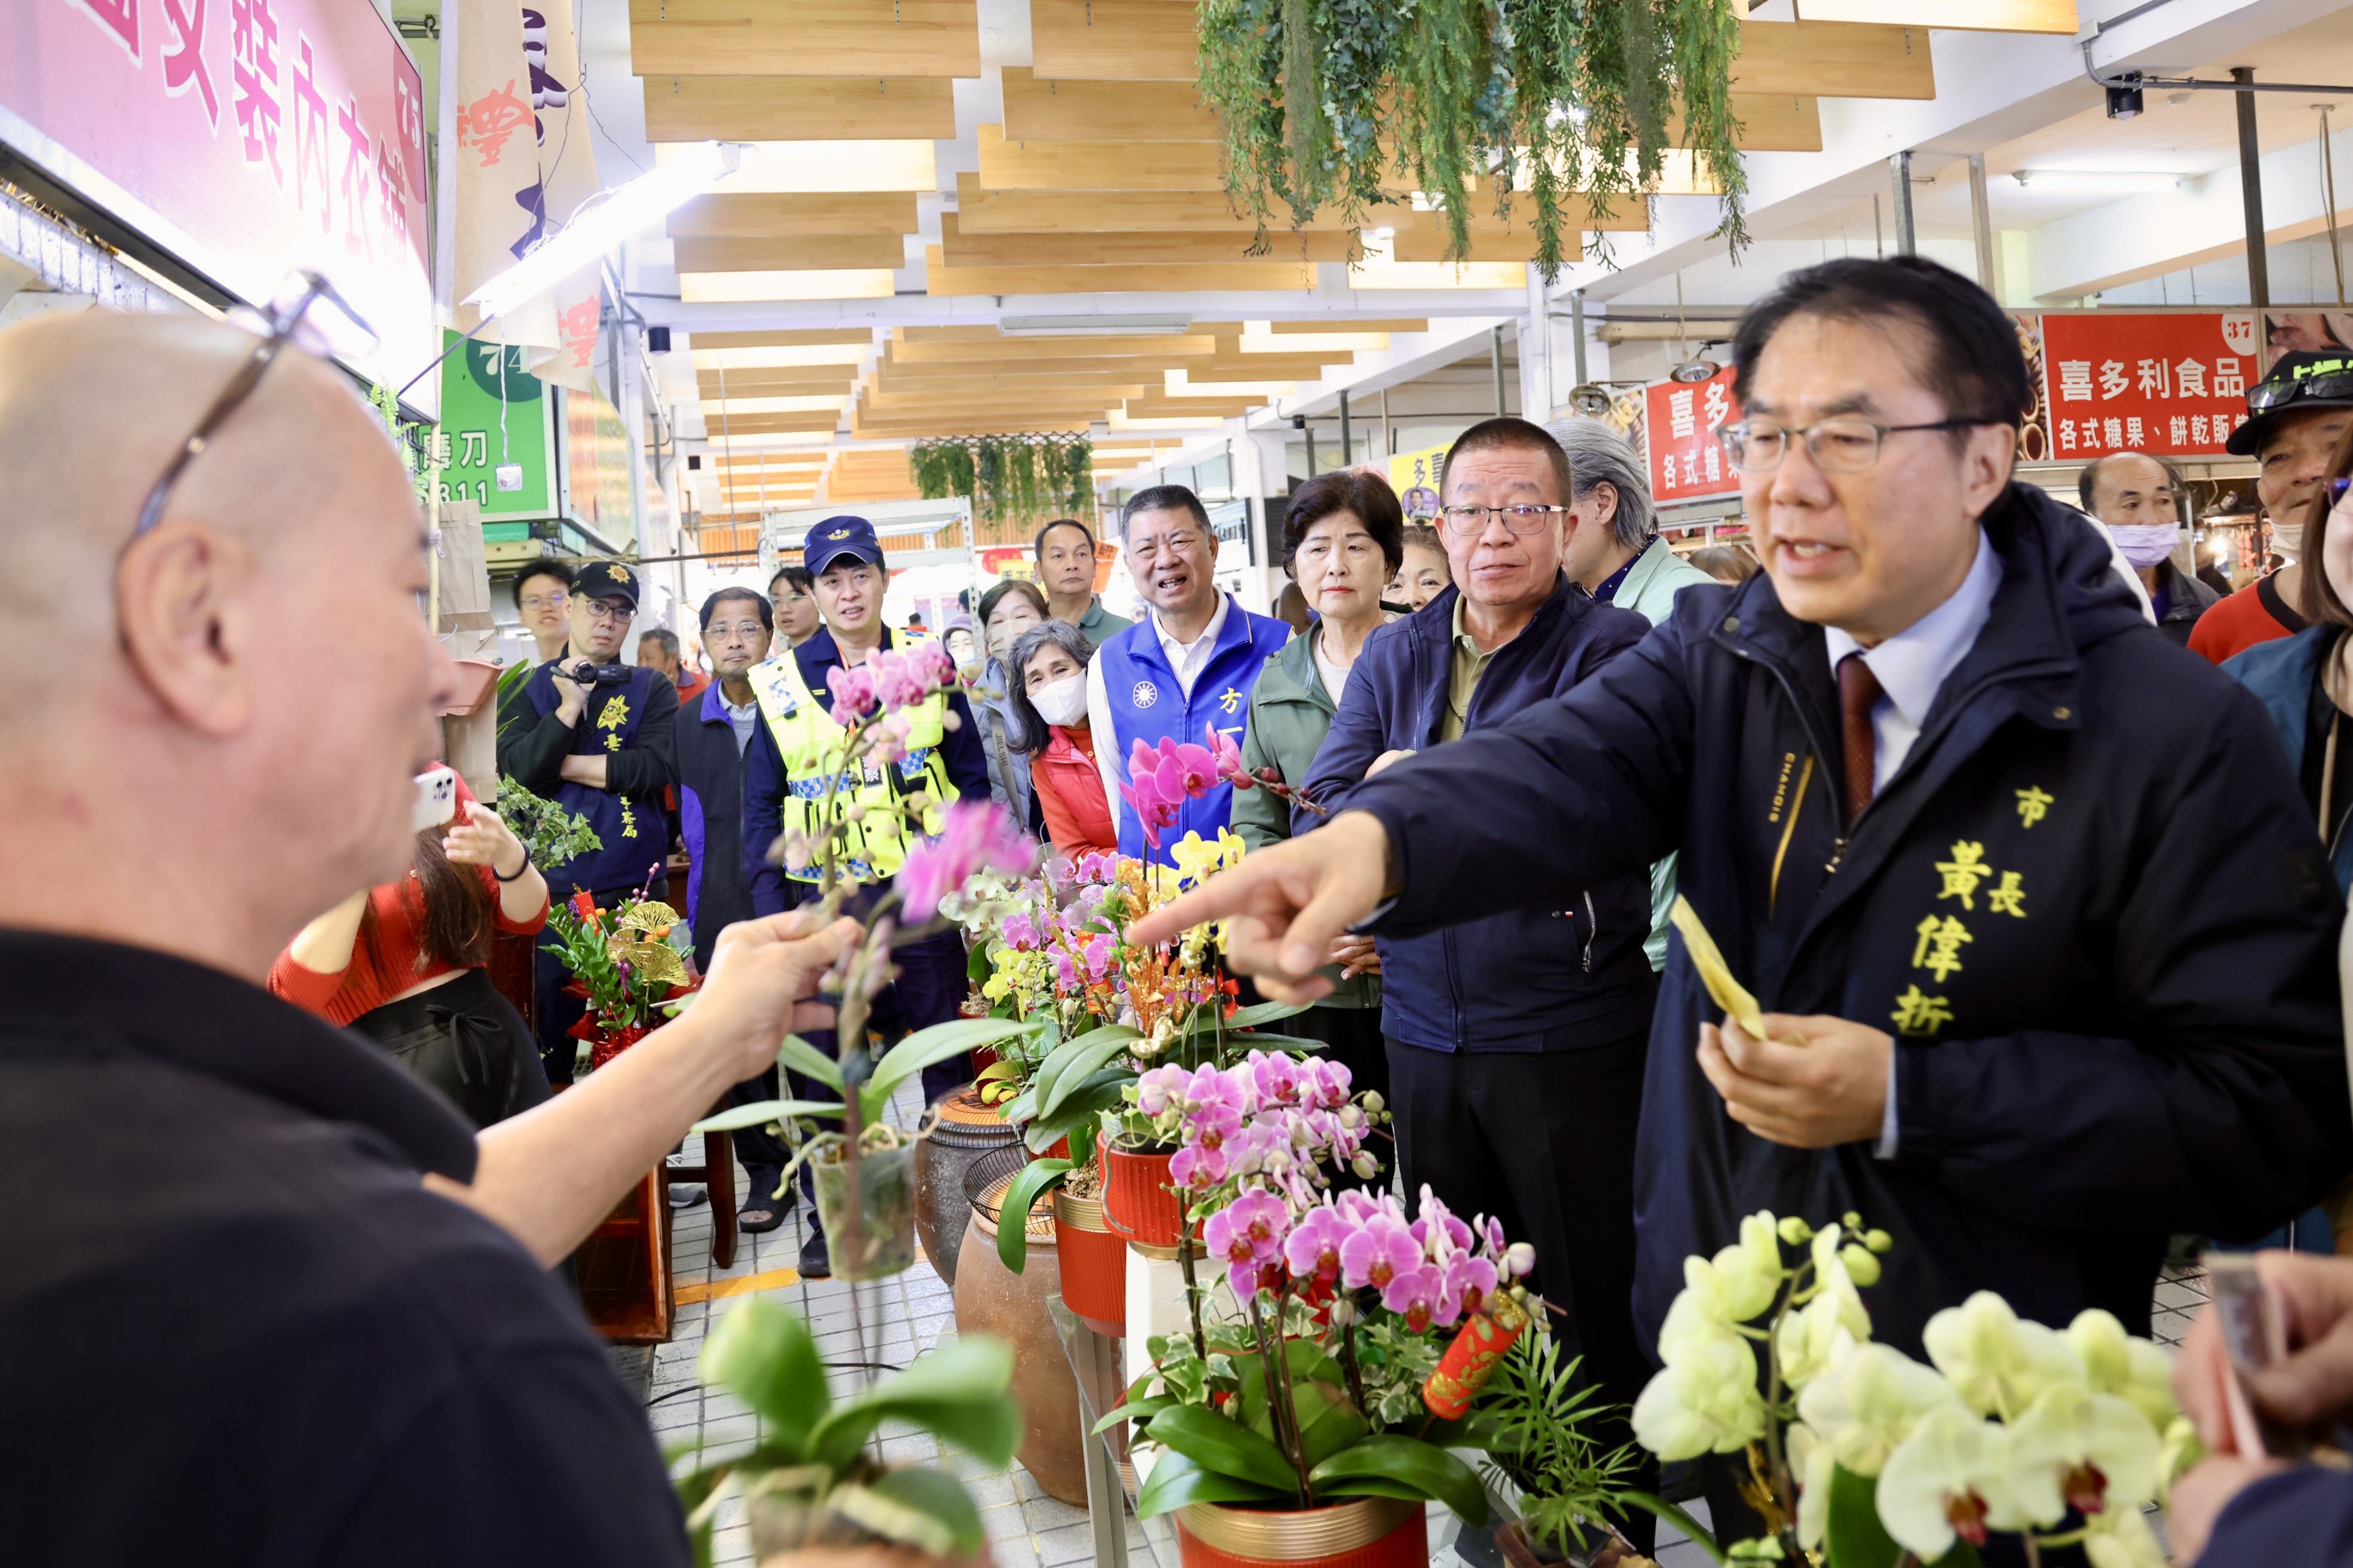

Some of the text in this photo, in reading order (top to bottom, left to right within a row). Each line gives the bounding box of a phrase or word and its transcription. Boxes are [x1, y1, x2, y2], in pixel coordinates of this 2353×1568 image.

[398, 75, 420, 151] 75
[2227, 321, 2251, 339] 37
[479, 344, 530, 376] 74
[2058, 357, 2246, 401] 喜多利食品
[1669, 381, 1730, 440] 喜多
[995, 734, 1009, 768] JIELSHI
